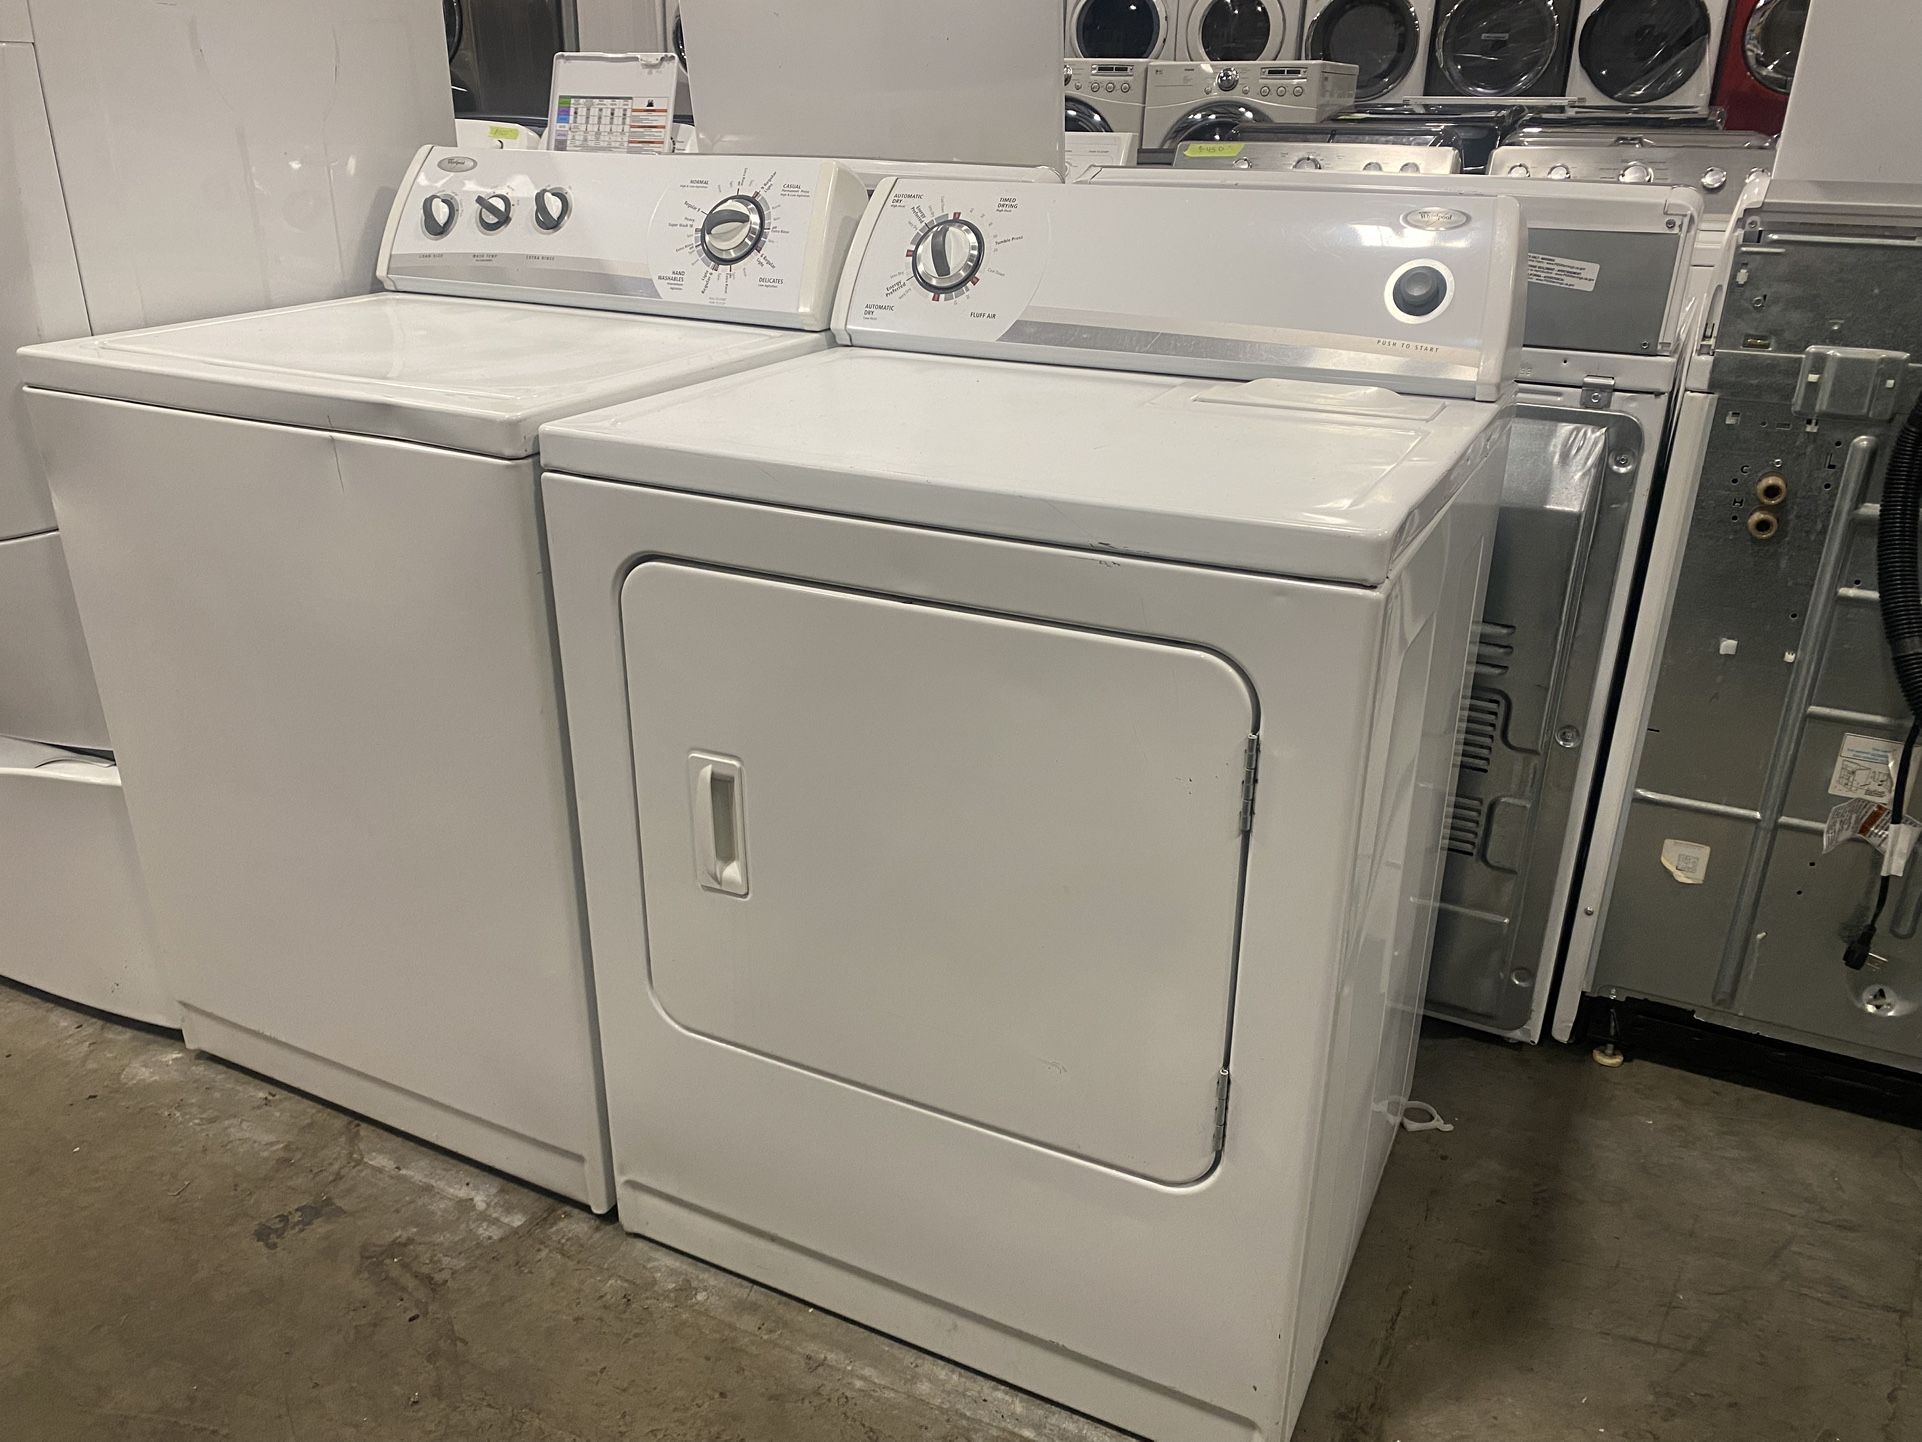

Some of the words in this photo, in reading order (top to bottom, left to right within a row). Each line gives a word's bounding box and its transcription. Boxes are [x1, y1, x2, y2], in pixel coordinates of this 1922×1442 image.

[684, 201, 698, 210] Regular
[915, 205, 926, 219] Energy
[911, 206, 924, 224] Preferred
[1418, 211, 1453, 221] Whirlpool
[763, 256, 776, 269] Regular
[885, 282, 907, 298] Preferred
[886, 279, 902, 292] Energy
[864, 303, 895, 311] AUTOMATIC
[1377, 339, 1397, 347] PUSH
[1415, 344, 1440, 353] START
